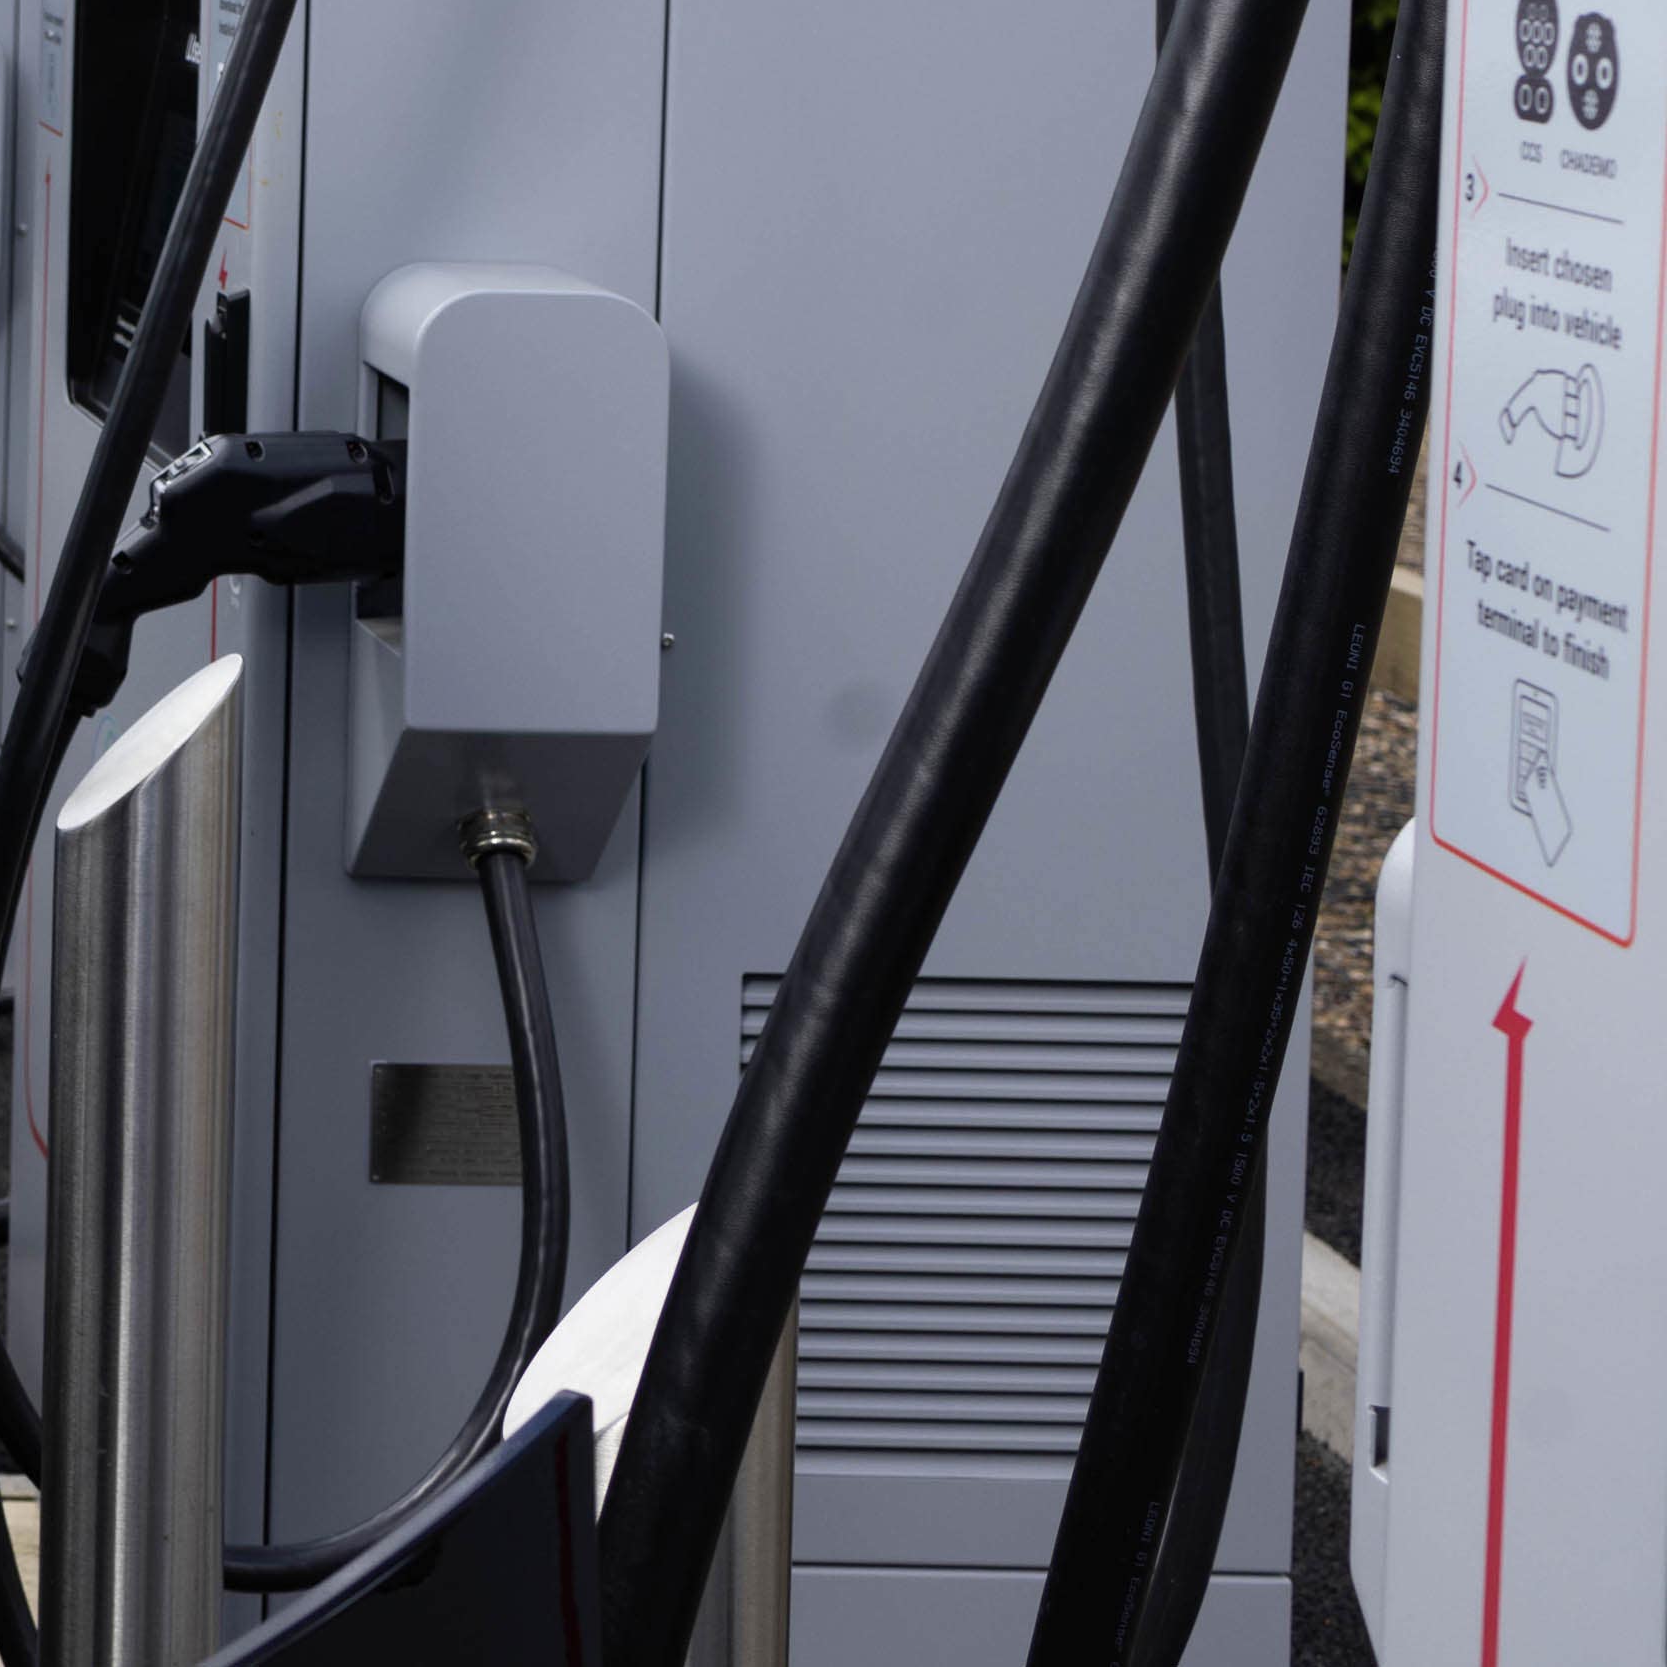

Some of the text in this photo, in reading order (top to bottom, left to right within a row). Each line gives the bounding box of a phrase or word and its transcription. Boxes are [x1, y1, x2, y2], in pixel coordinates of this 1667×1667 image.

[1465, 173, 1475, 202] 3
[1506, 237, 1613, 293] Insert chosen
[1419, 306, 1434, 327] DC
[1492, 286, 1622, 350] plug into vehicle
[1453, 461, 1462, 489] 4
[1467, 538, 1627, 633] Tap card on payment
[1346, 623, 1367, 671] LEONI
[1477, 598, 1609, 681] terminal to finish
[1308, 805, 1329, 856] 62893
[1299, 864, 1316, 894] IEC
